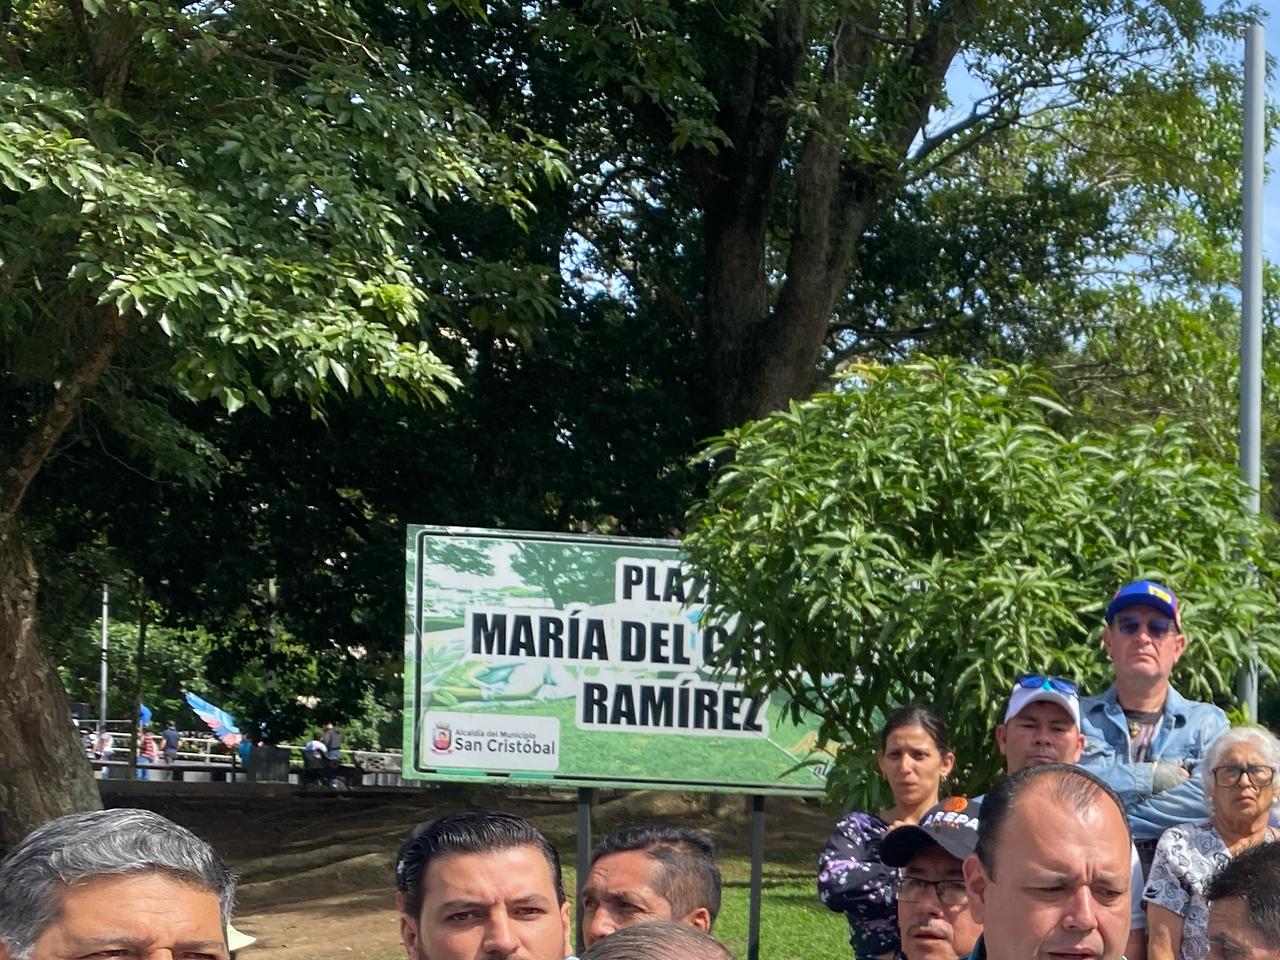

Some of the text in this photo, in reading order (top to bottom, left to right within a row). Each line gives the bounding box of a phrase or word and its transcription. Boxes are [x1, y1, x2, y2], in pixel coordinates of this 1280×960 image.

[471, 609, 608, 661] MARÍA
[620, 620, 691, 665] DEL
[582, 679, 763, 732] RAMÍREZ
[486, 730, 498, 738] del
[499, 730, 536, 741] Municipio
[454, 737, 555, 755] San Cristóbal
[922, 811, 979, 831] AREPA
